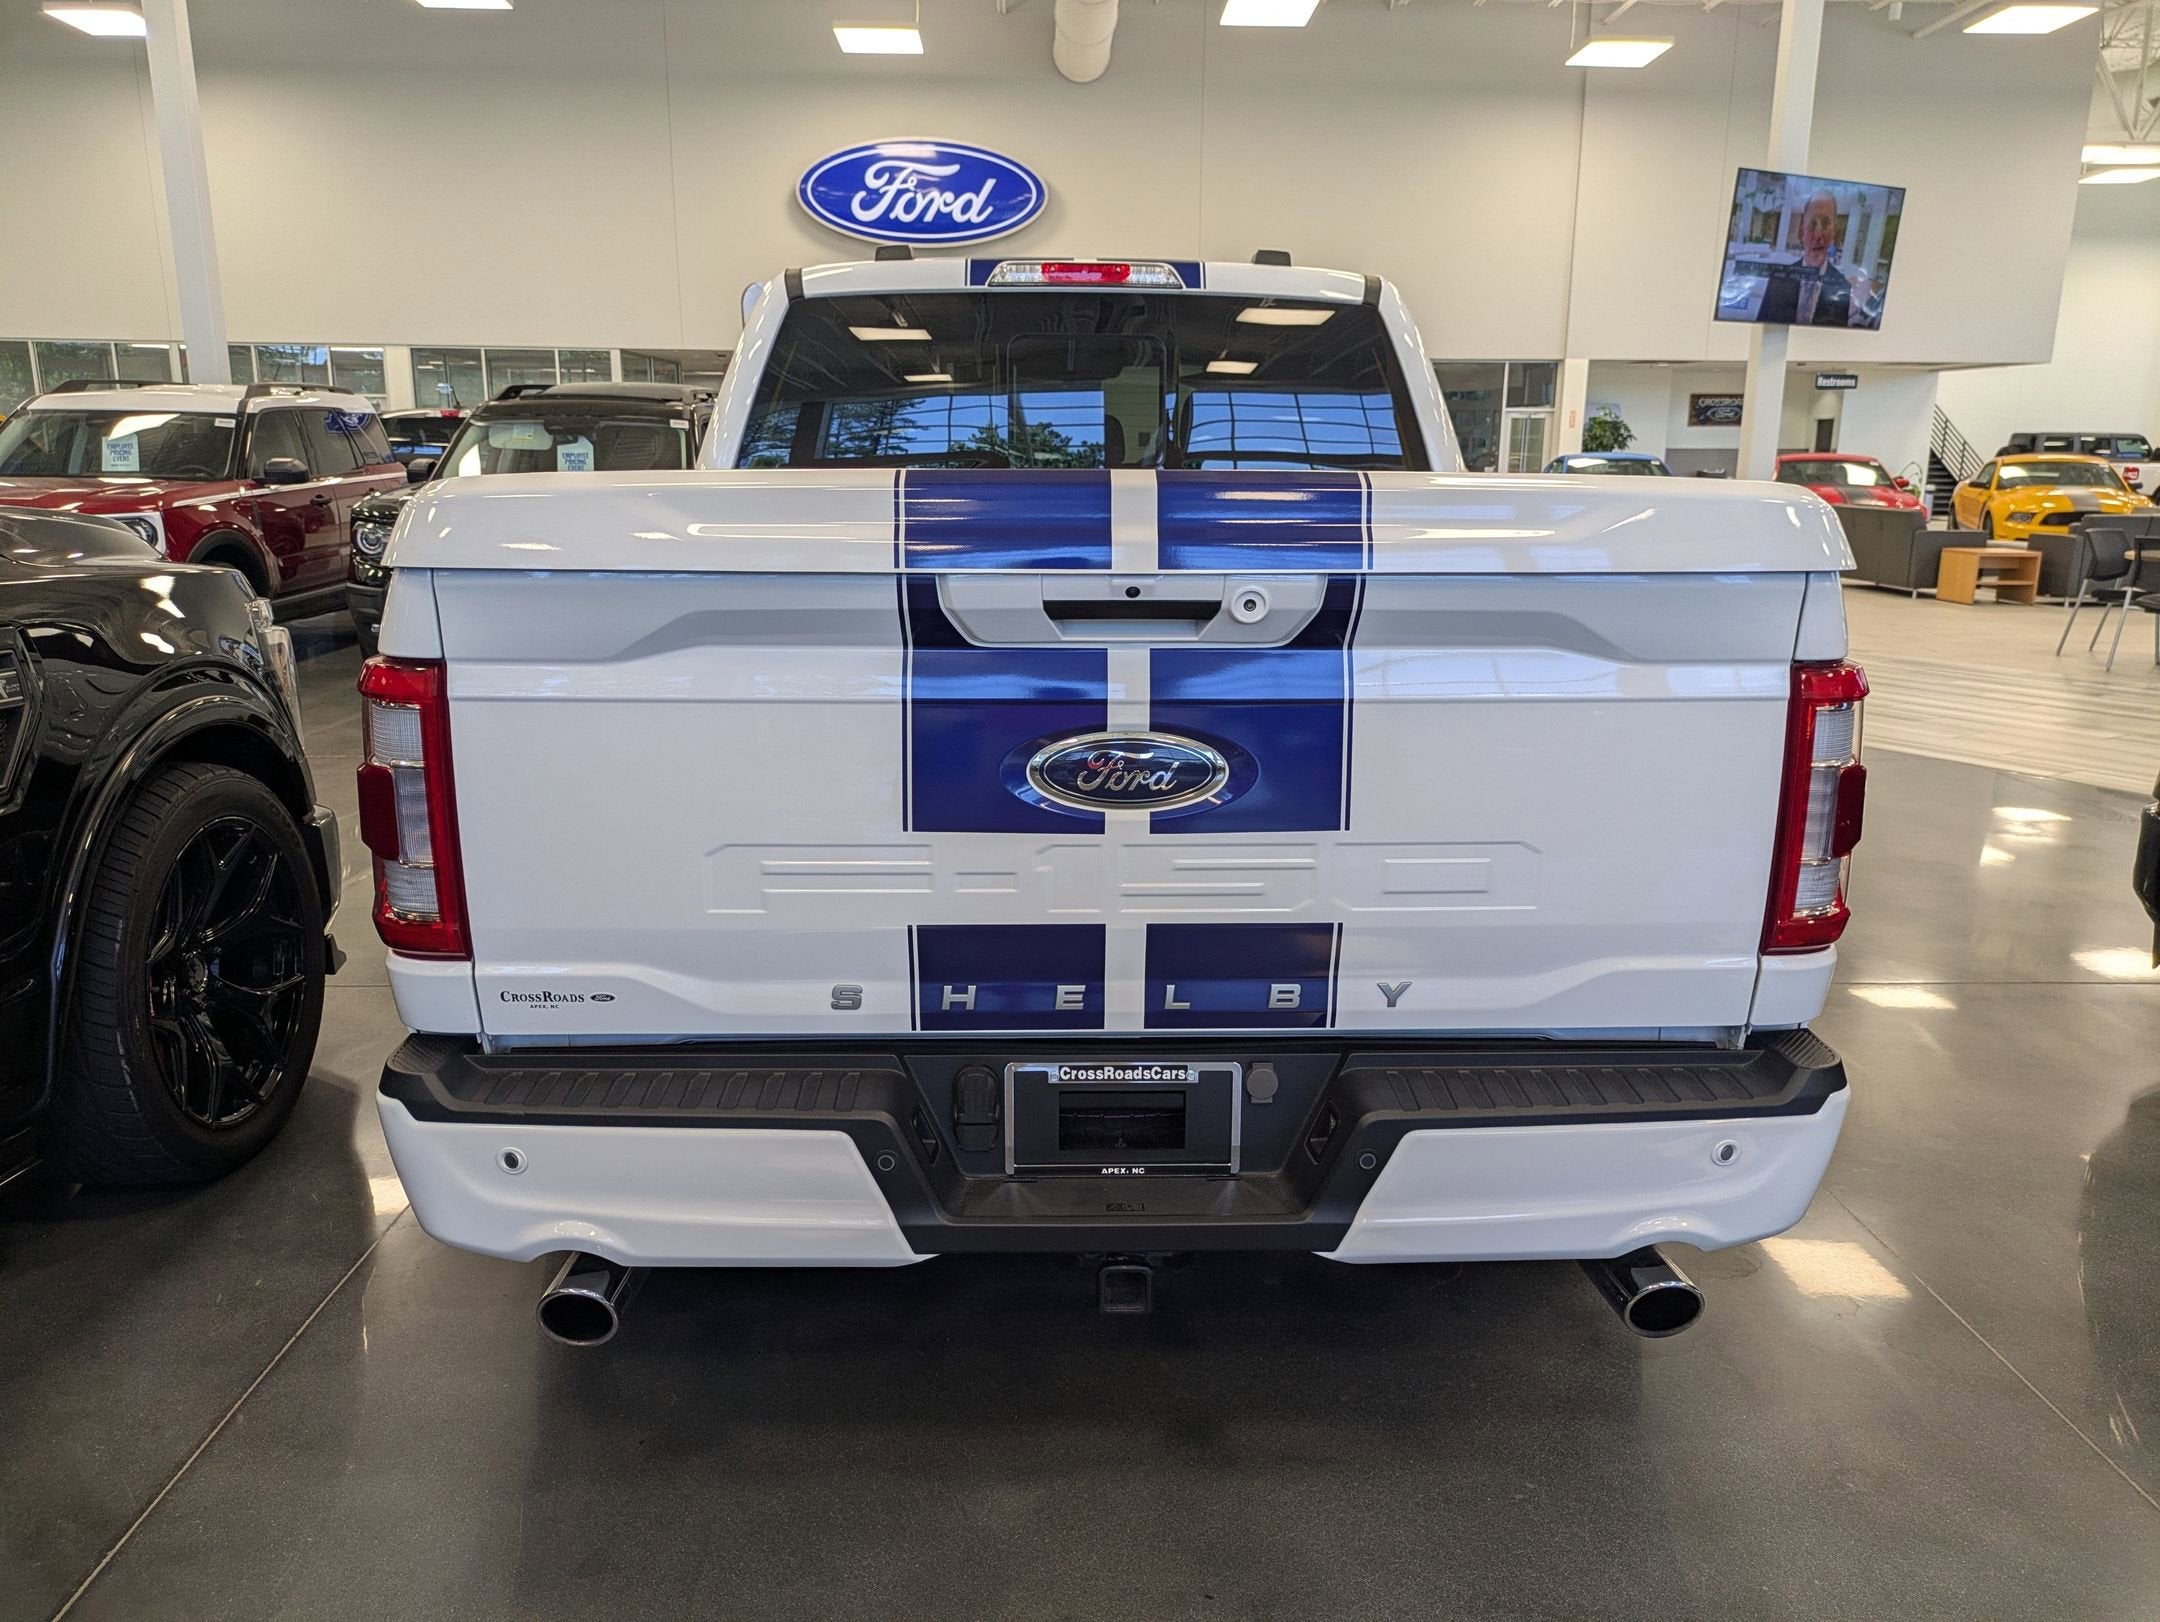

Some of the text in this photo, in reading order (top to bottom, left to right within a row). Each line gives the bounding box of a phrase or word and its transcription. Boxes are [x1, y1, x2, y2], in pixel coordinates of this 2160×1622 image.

[851, 159, 997, 224] Ford
[1816, 377, 1855, 387] Restrooms
[1698, 398, 1743, 408] CROSSROA
[1714, 409, 1735, 418] Ford
[1076, 749, 1180, 792] Ford
[703, 841, 1543, 914] F-150
[1059, 1066, 1186, 1081] CrossRoadsCars
